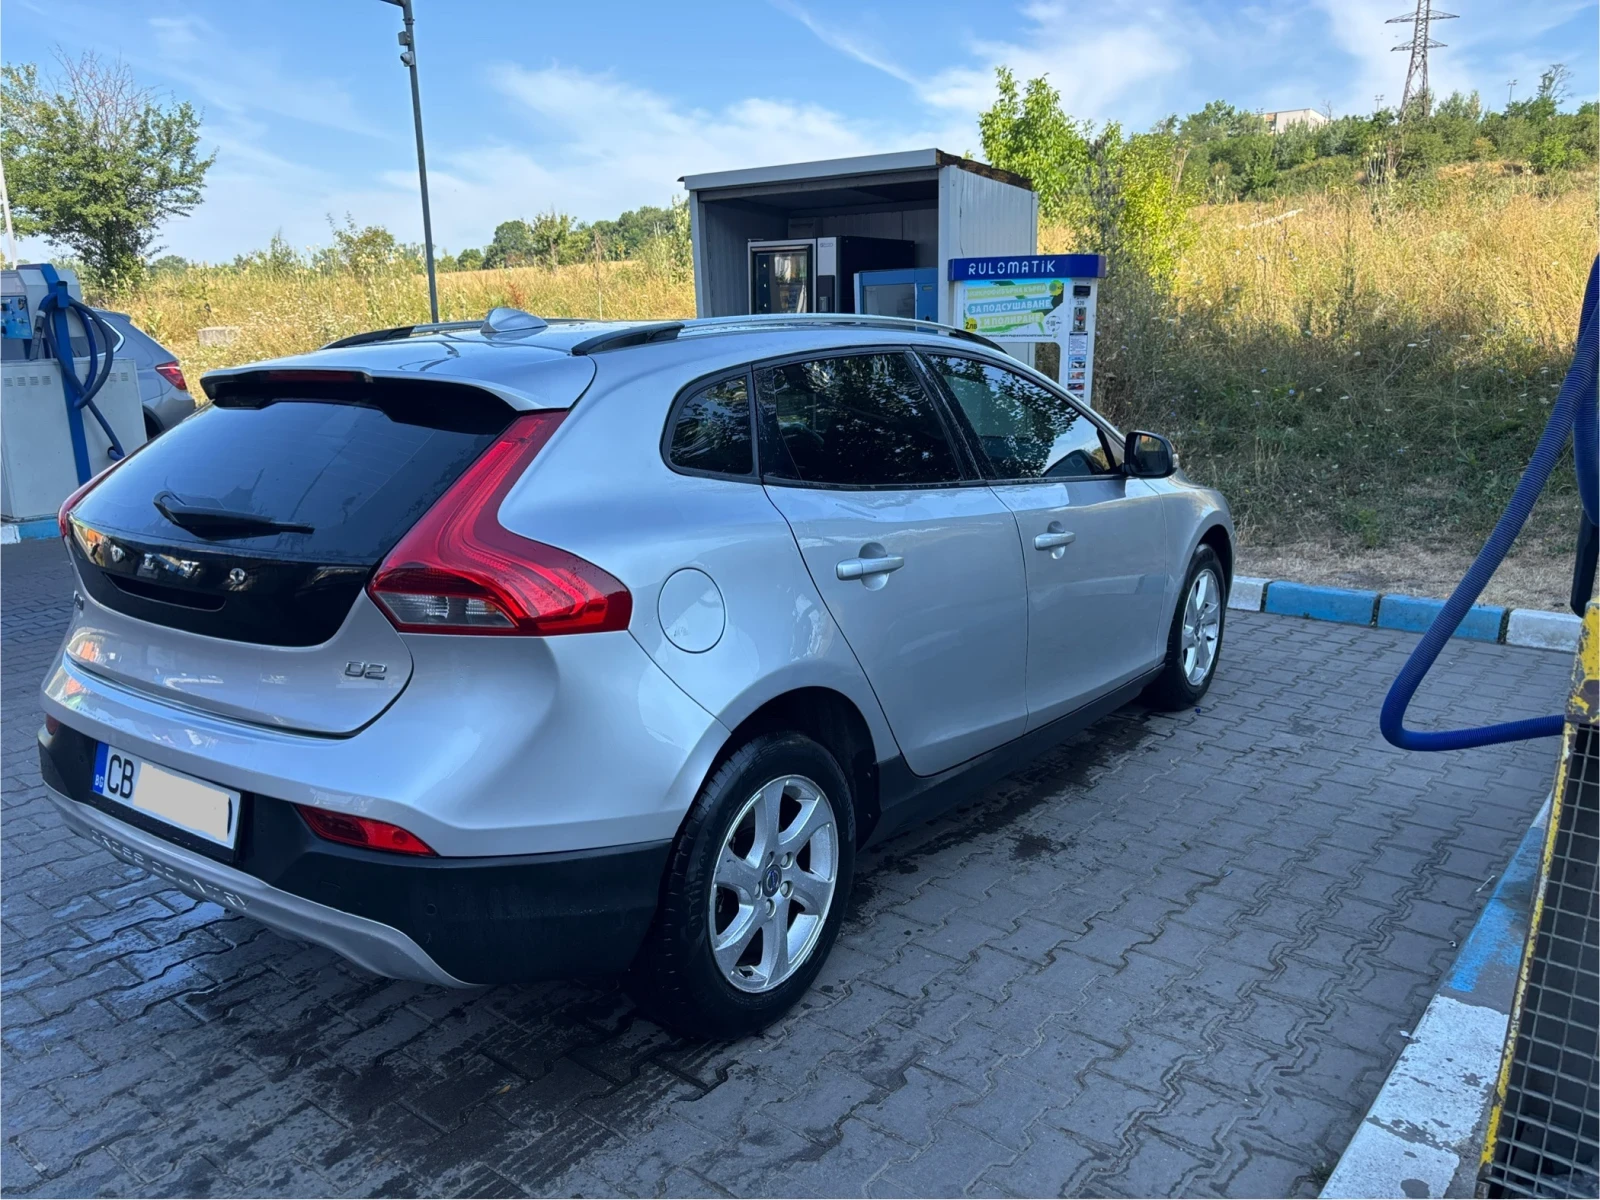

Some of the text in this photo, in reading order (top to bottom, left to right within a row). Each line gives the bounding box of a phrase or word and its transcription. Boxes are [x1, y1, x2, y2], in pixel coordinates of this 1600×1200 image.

[971, 299, 1051, 313] ЗА ПОДСУШАВАНЕ
[984, 318, 990, 326] И
[991, 314, 1041, 325] ПОЛИРАНЕ
[345, 660, 387, 681] D2
[94, 774, 104, 789] BG
